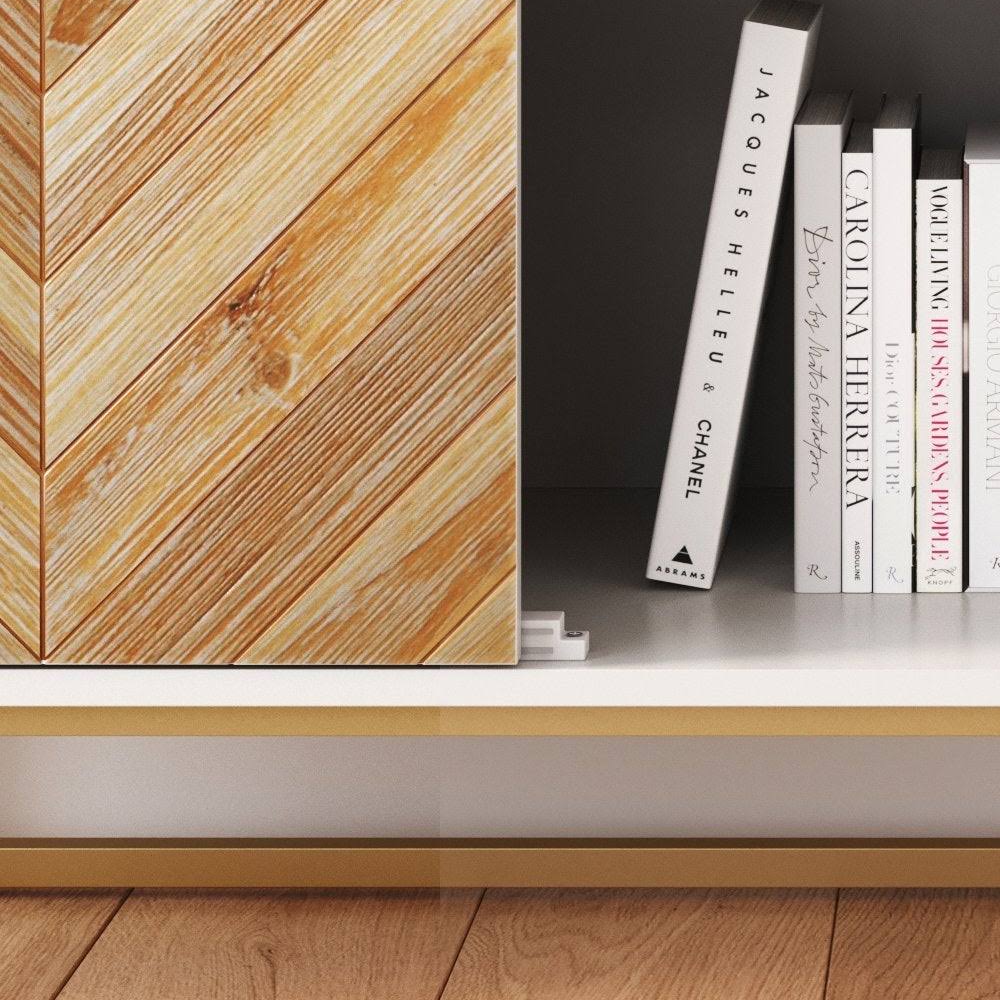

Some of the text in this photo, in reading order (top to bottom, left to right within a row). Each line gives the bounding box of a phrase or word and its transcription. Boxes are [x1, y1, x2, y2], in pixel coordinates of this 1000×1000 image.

[930, 185, 949, 243] VOGUE
[684, 67, 774, 500] JACQUES HELLEU & CHANEL
[930, 248, 949, 310] LIVING
[845, 168, 869, 510] CAROLINA HERRERA
[885, 342, 900, 495] Dior COUTURE
[931, 489, 949, 561] PEOPLE
[656, 565, 706, 580] ABRAMS
[853, 540, 861, 581] ASSOULINE
